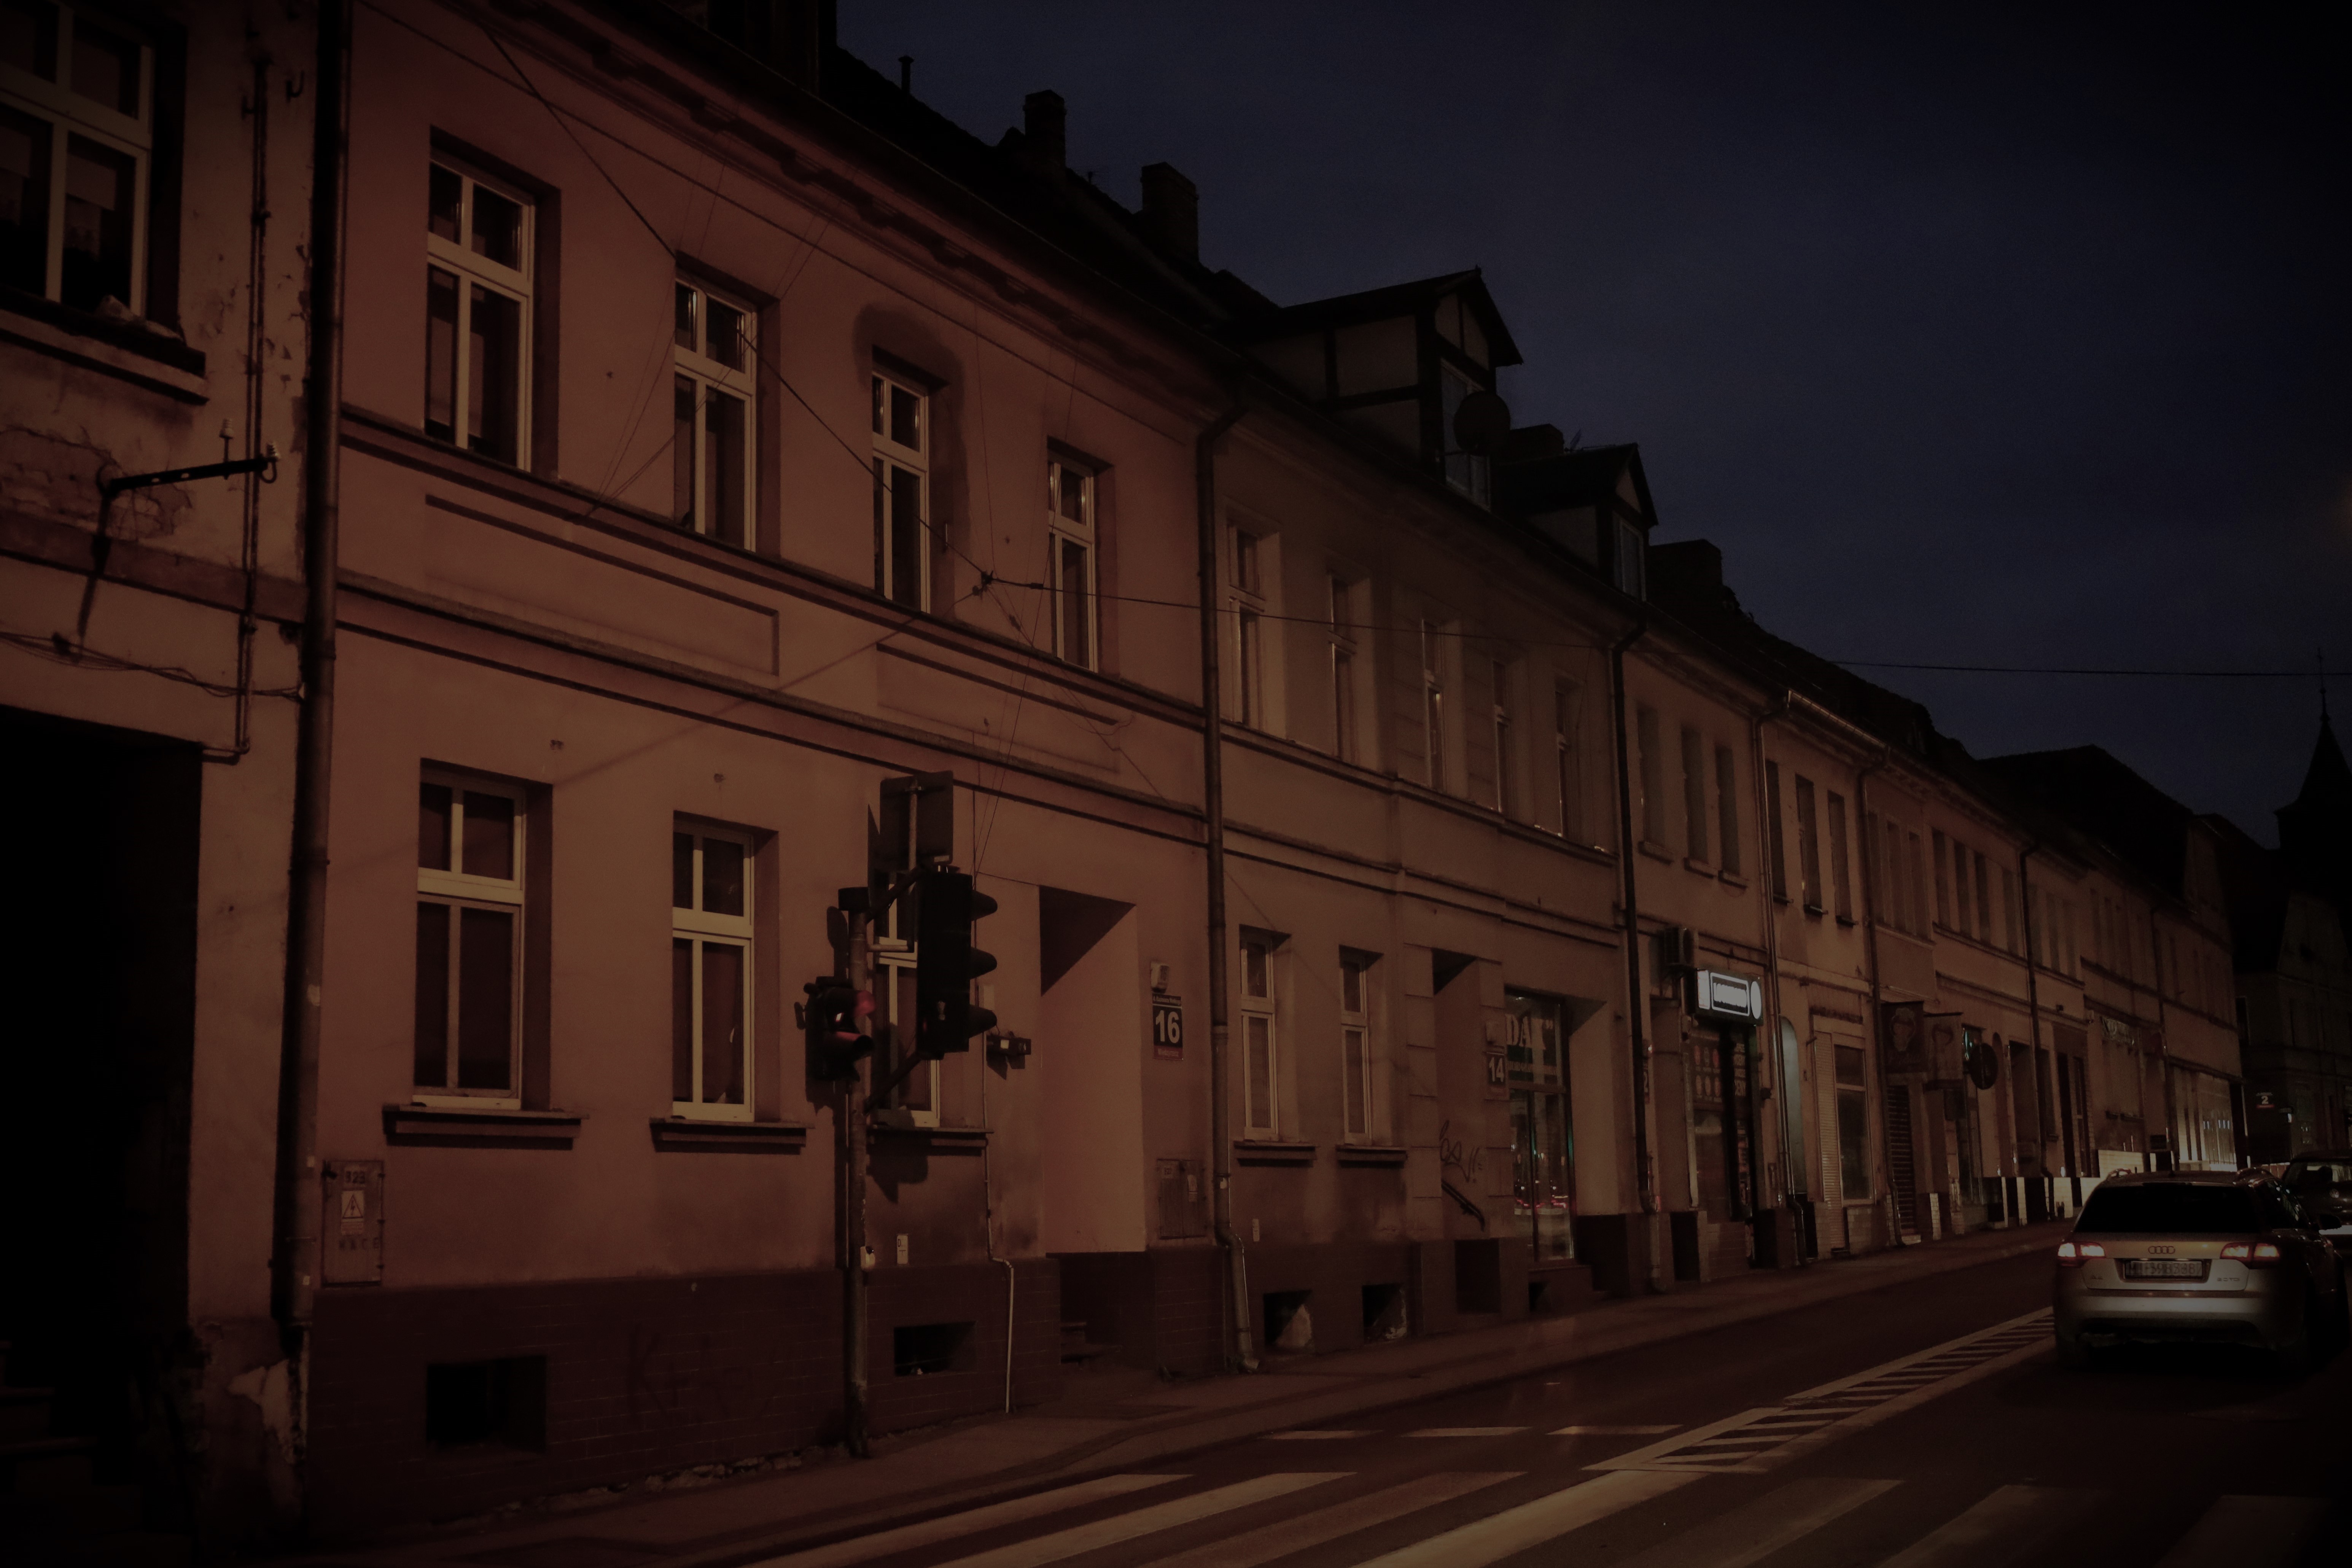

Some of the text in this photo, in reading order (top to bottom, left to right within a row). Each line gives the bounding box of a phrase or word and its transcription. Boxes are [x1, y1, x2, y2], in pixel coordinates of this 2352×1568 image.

[1155, 1010, 1180, 1043] 16
[1489, 1057, 1505, 1082] 14
[2261, 1096, 2269, 1105] 2
